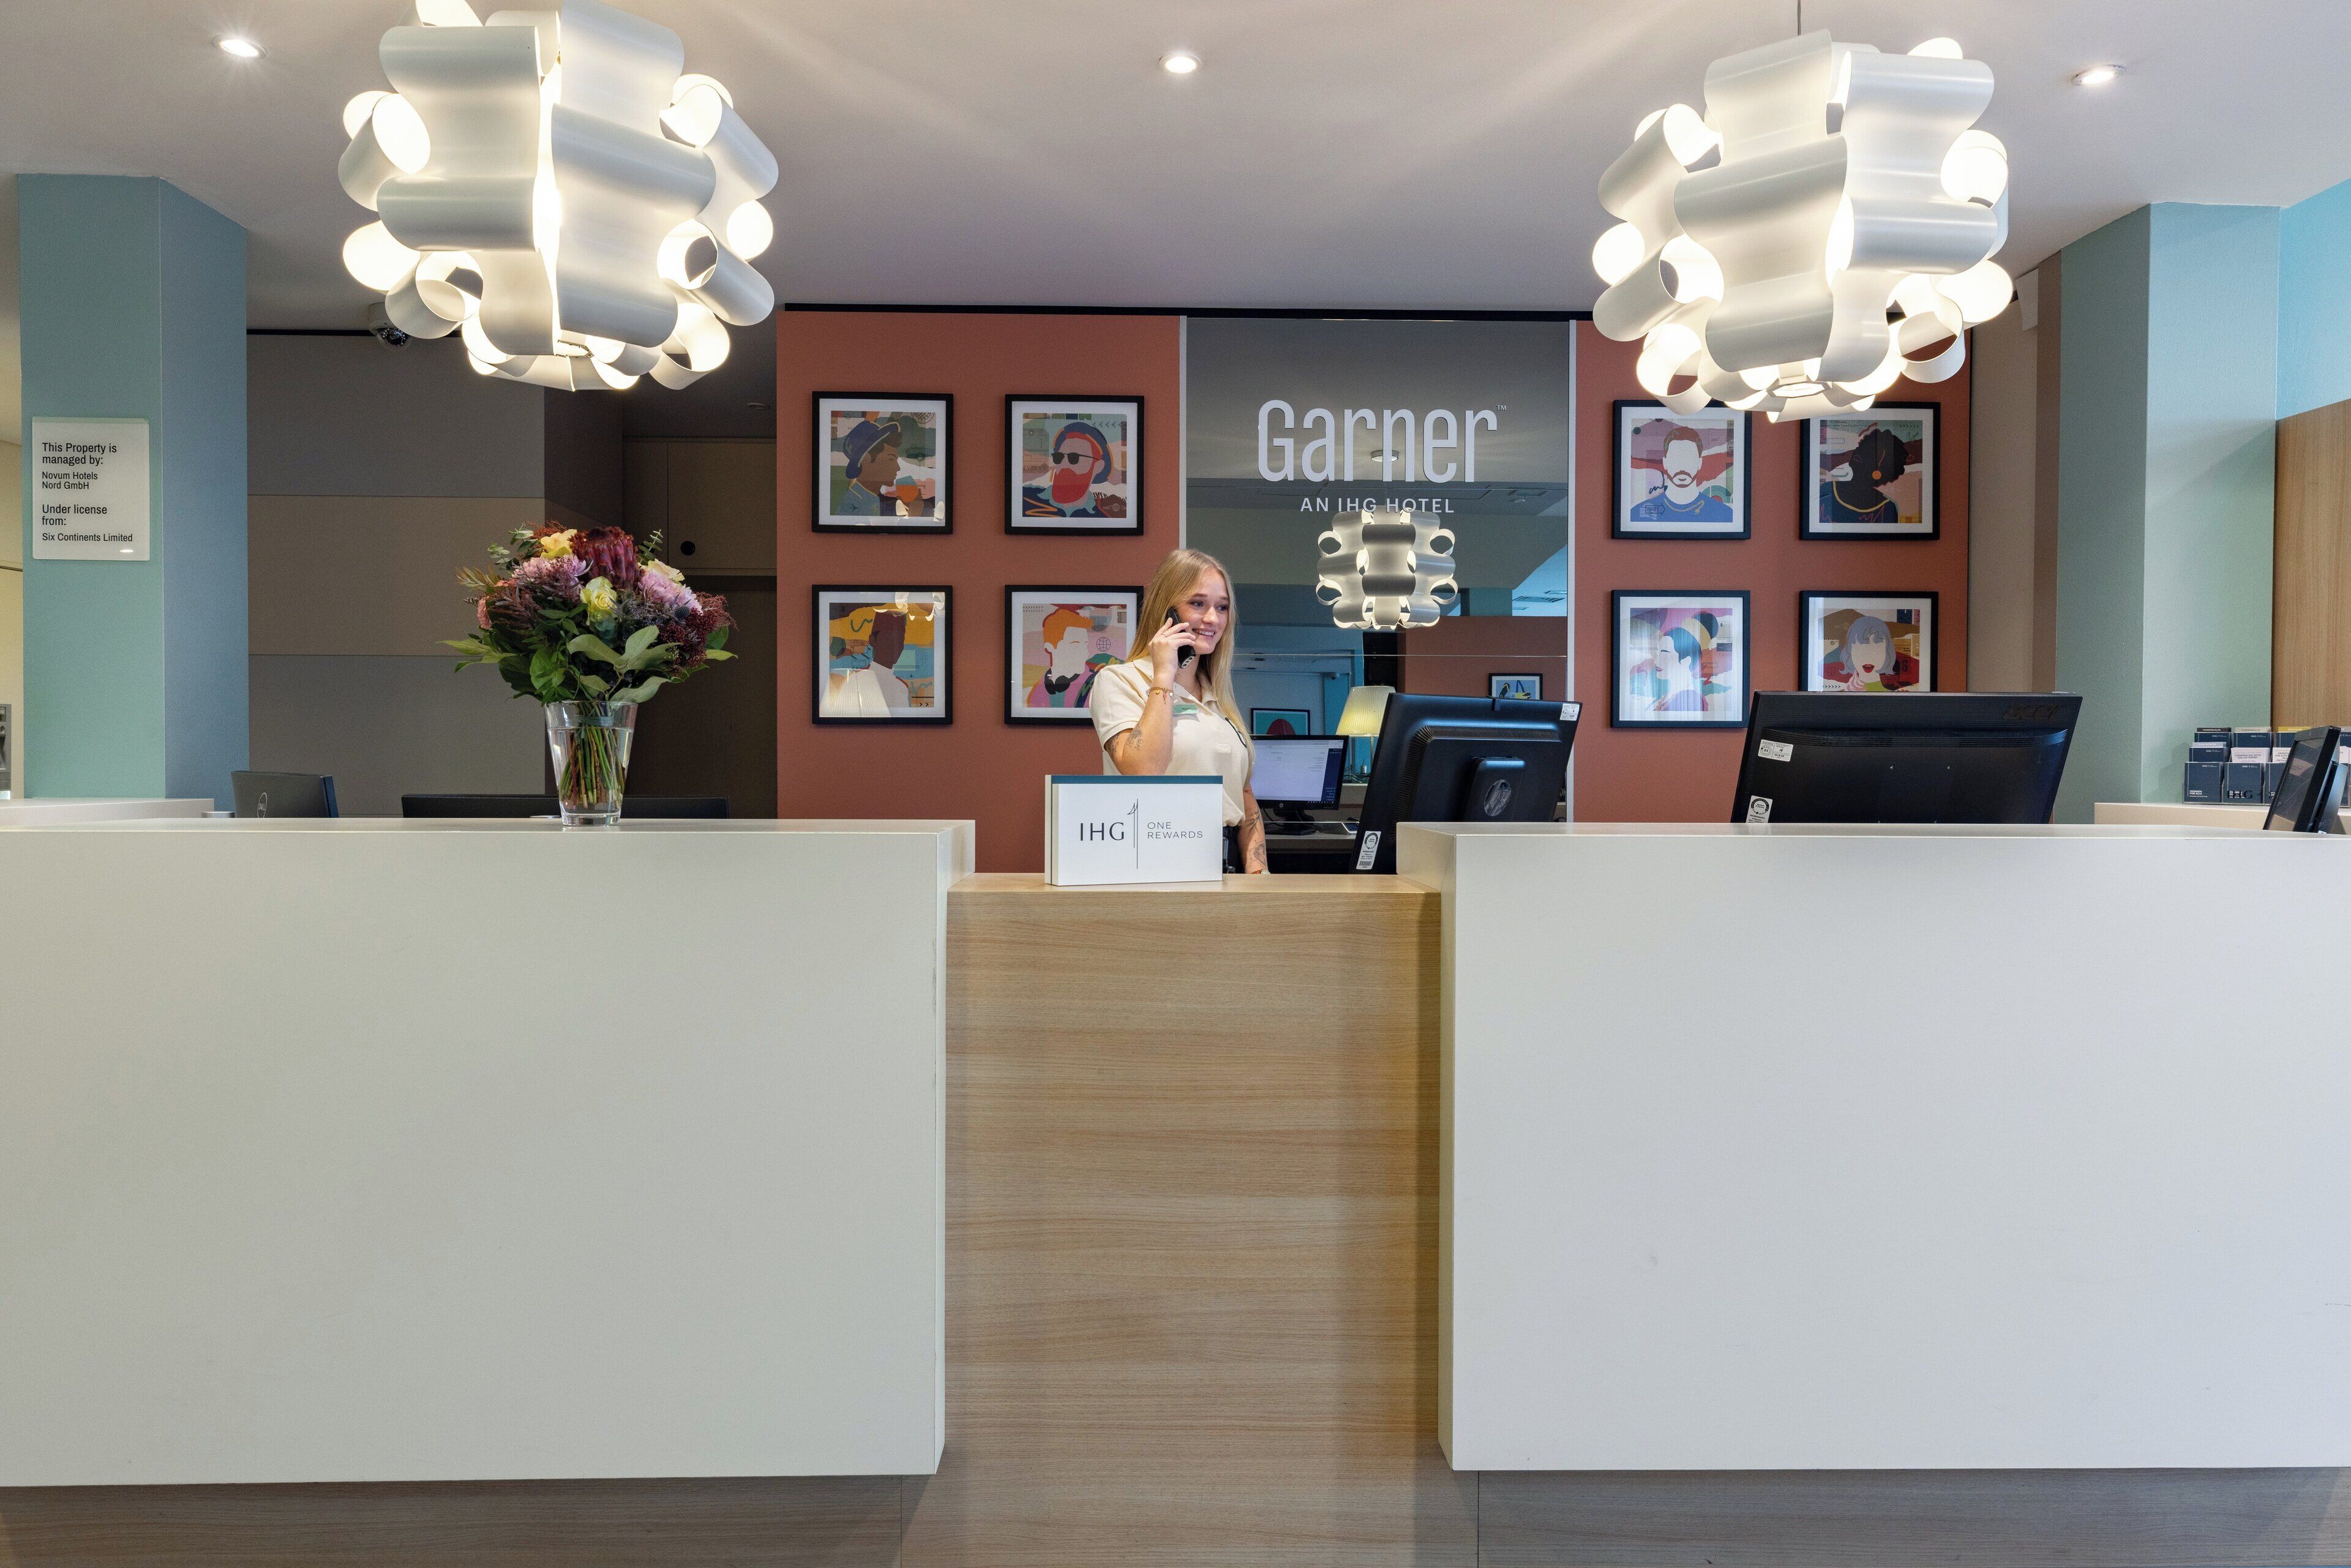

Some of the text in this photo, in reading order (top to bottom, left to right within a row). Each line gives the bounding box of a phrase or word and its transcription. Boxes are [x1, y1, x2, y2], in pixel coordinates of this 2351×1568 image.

[1258, 400, 1498, 483] Garner
[42, 443, 117, 454] This Property is
[42, 455, 103, 466] managed by:
[42, 471, 70, 479] Novum
[42, 505, 108, 514] Under license
[1300, 498, 1454, 513] AN IHG HOTEL
[42, 516, 66, 525] from:
[58, 533, 101, 541] Continents
[103, 533, 133, 542] Limited
[1080, 822, 1125, 841] IHG
[1147, 830, 1203, 839] REWARDS
